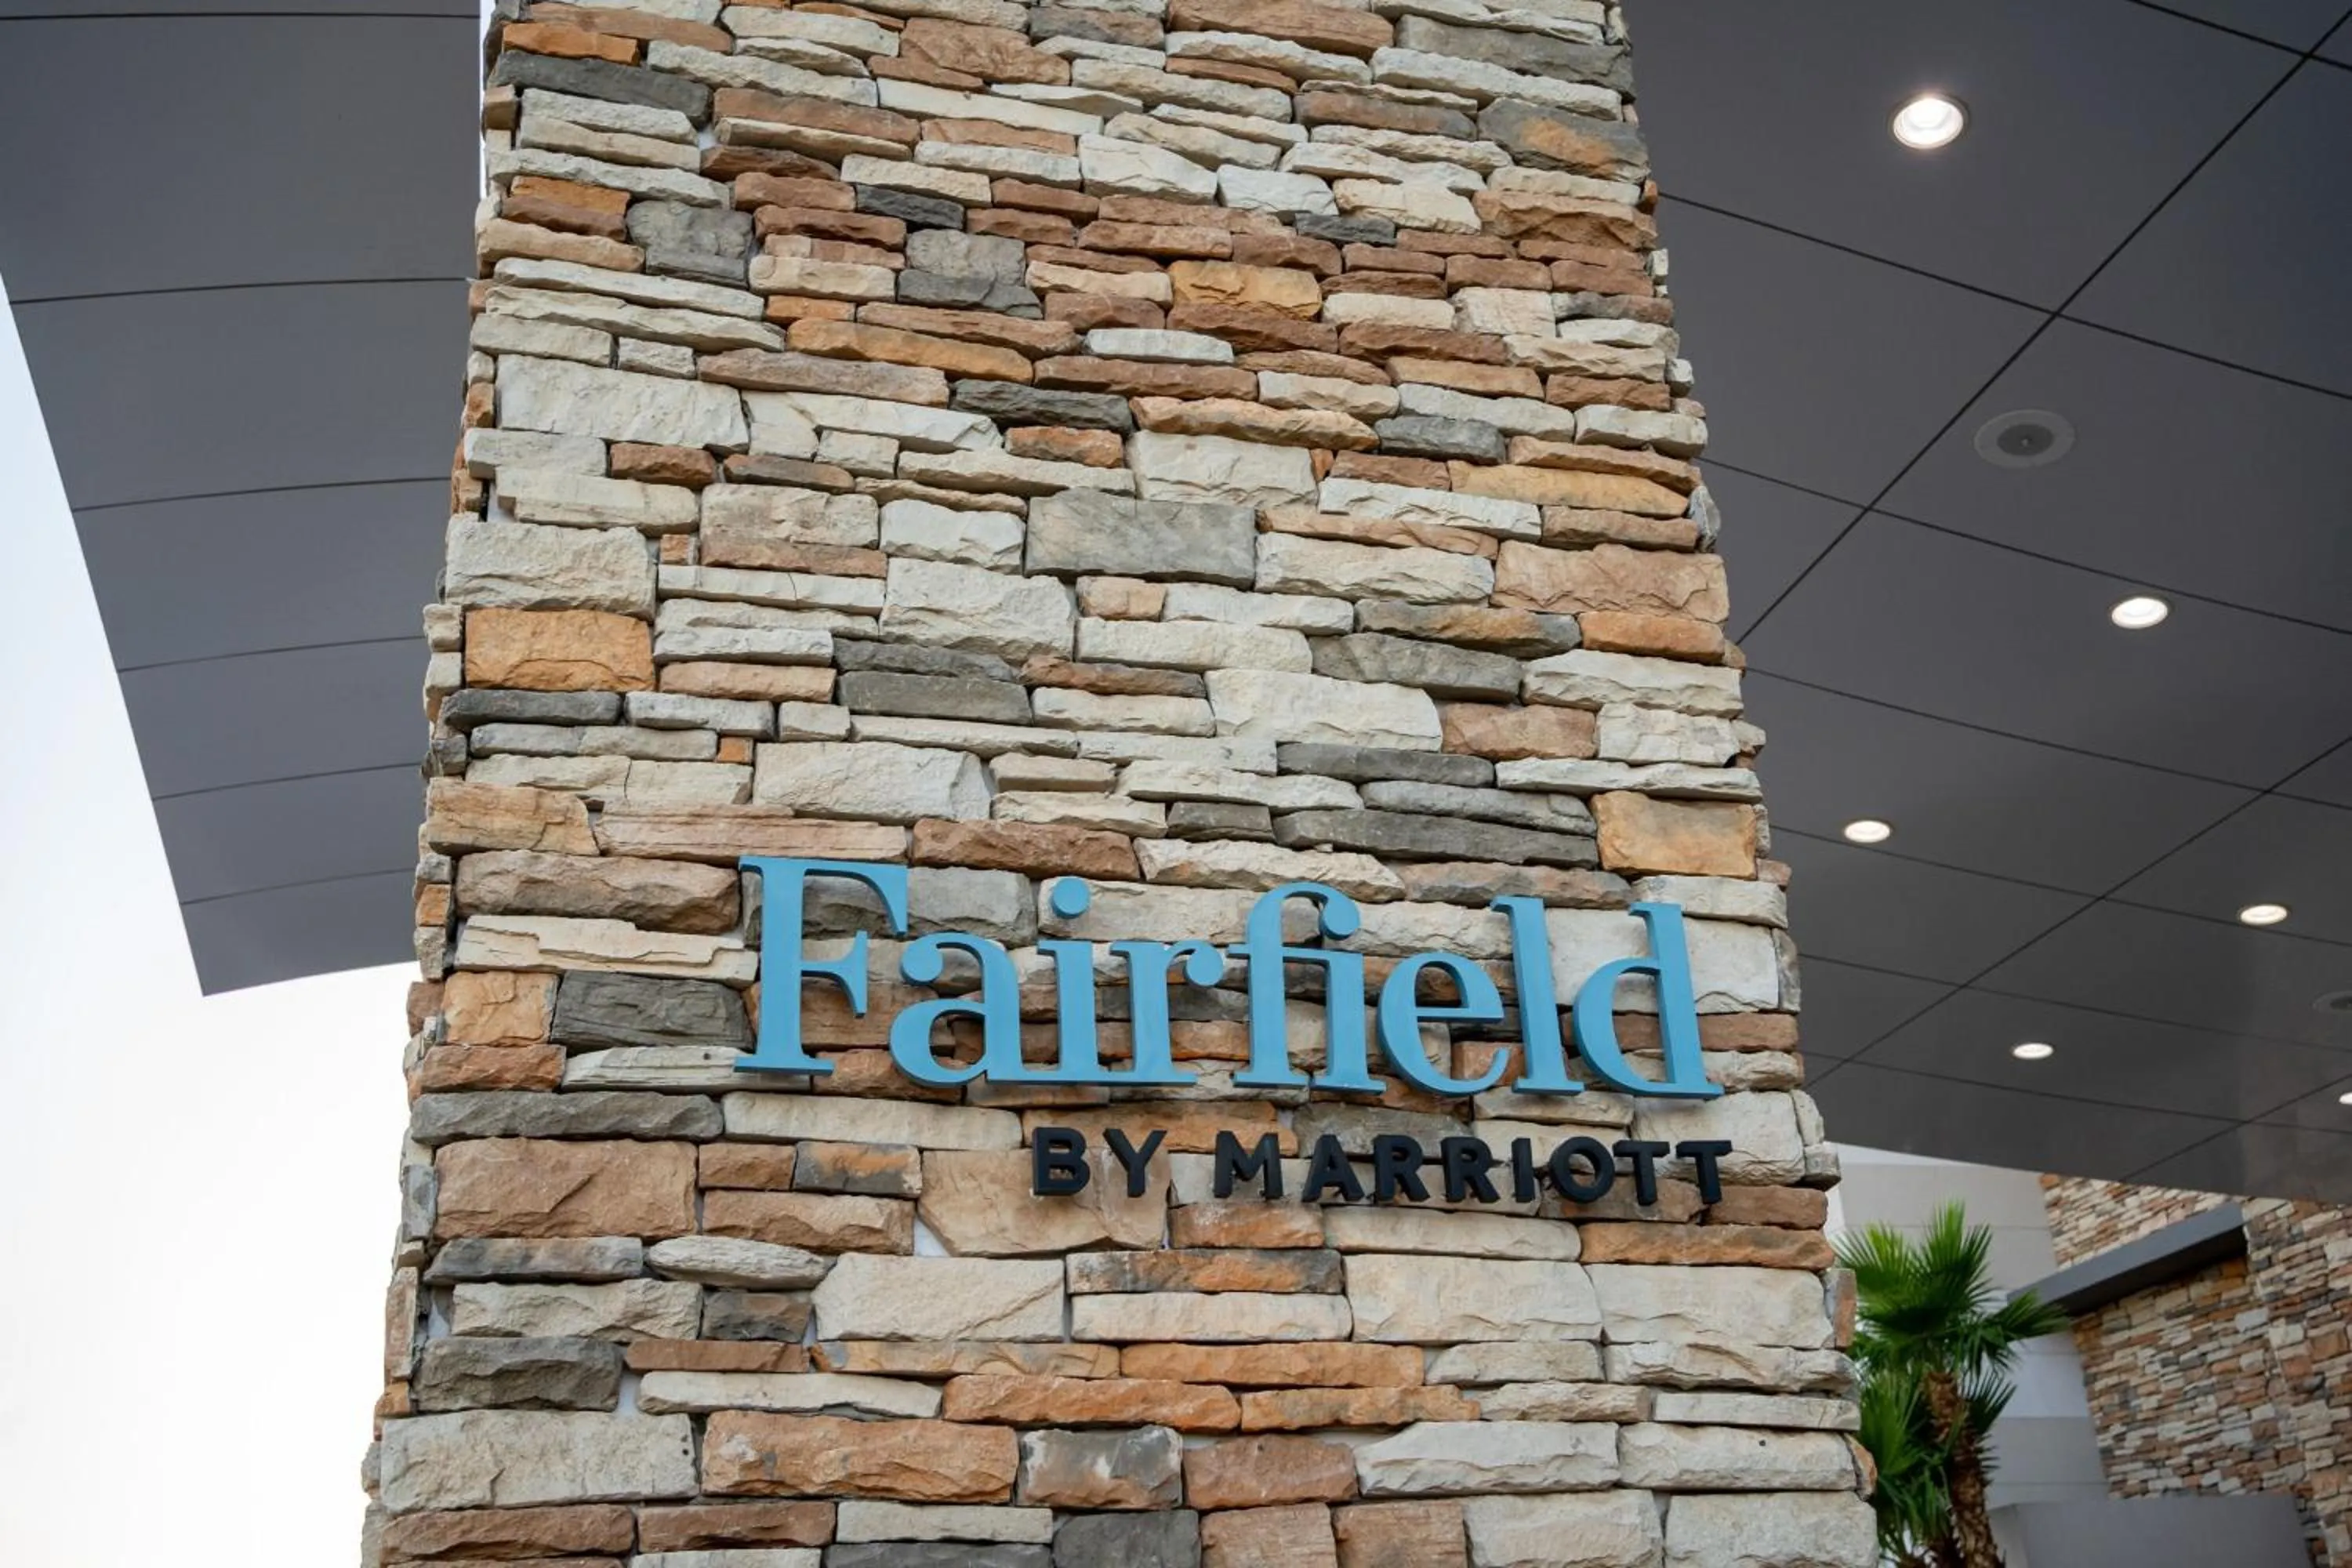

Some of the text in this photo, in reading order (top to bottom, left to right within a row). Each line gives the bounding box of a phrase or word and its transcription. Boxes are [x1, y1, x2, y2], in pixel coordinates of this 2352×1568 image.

[735, 855, 1723, 1098] Fairfield
[1033, 1127, 1732, 1206] BY MARRIOTT
